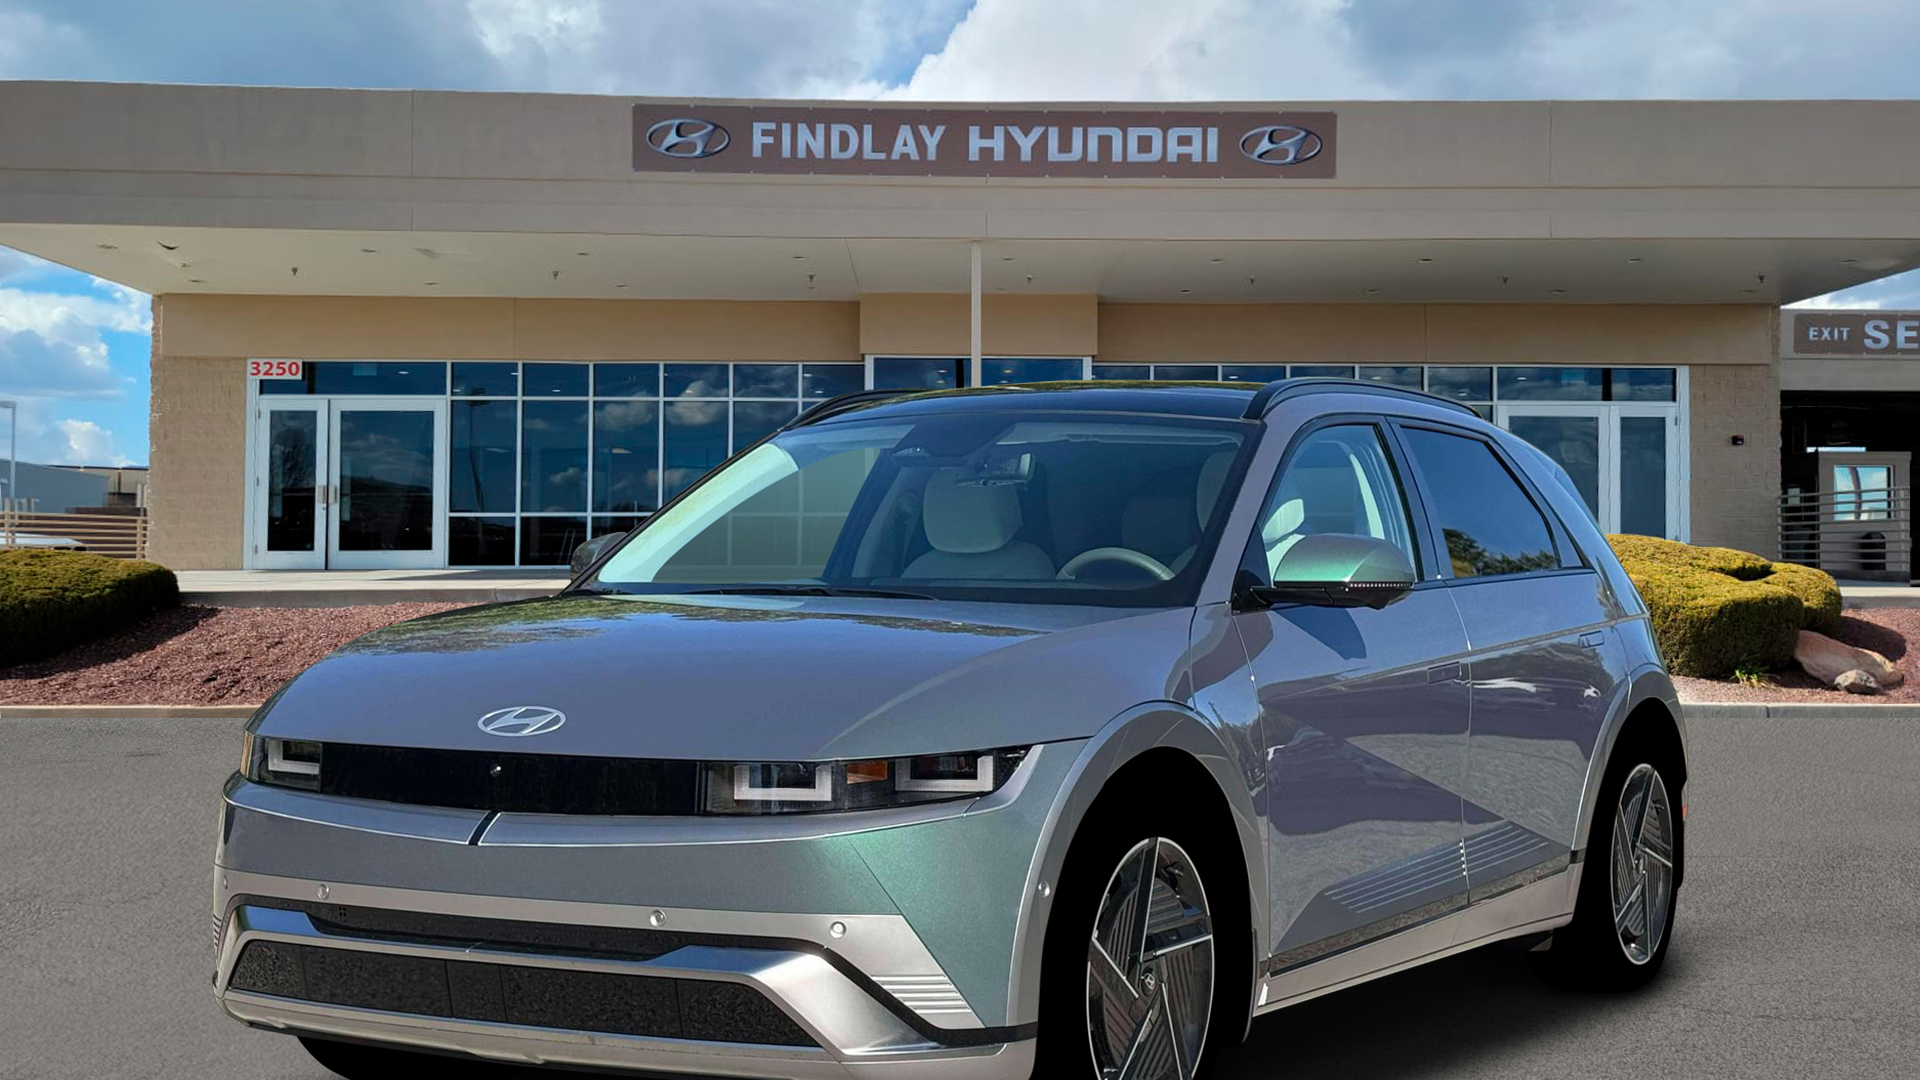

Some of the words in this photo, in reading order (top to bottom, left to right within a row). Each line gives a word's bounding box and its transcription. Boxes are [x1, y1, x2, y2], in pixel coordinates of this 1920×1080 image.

[751, 121, 946, 162] FINDLAY
[968, 126, 1219, 163] HYUNDAI
[1808, 327, 1850, 341] EXIT
[249, 361, 300, 376] 3250
